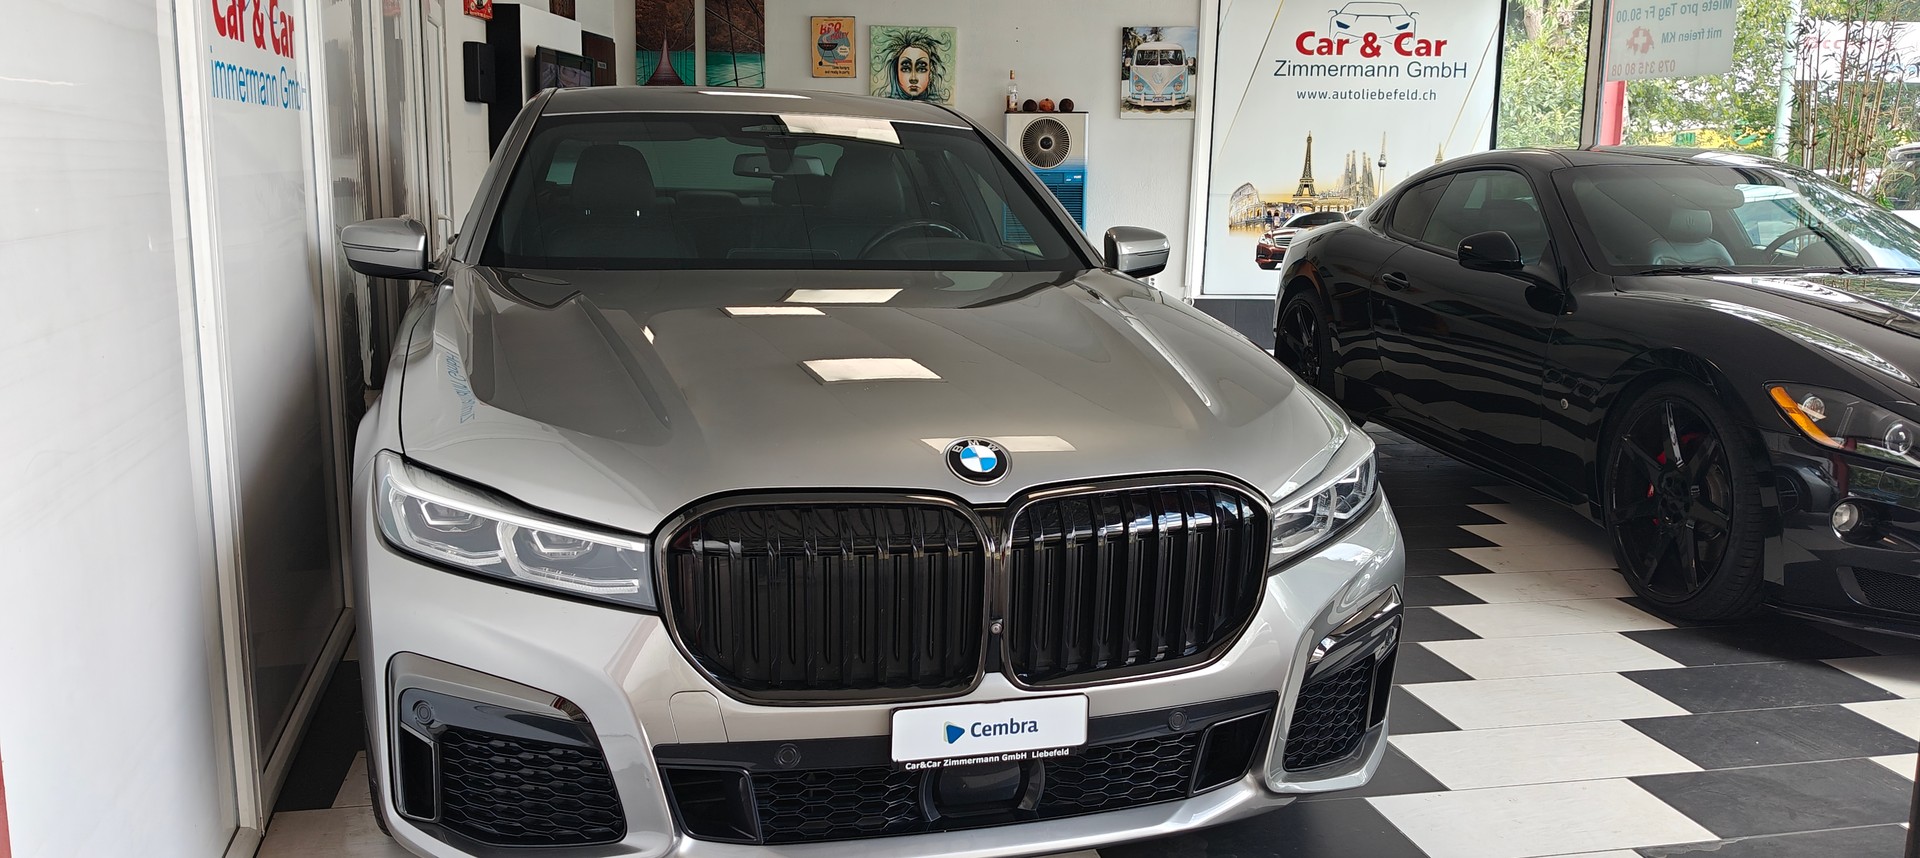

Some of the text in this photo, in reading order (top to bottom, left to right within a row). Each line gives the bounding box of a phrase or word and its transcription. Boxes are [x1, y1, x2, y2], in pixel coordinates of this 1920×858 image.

[212, 0, 294, 59] Car & Car
[1295, 31, 1447, 58] Car & Car
[210, 45, 308, 111] immermann GmbH
[1273, 60, 1467, 78] Zimmermann GmbH
[1297, 89, 1436, 101] www.autoliebefeld.ch
[952, 440, 999, 453] BMW
[970, 718, 1039, 738] Cembra
[905, 748, 1069, 771] Car&Car Zimmermann GmbH Liebefeld
